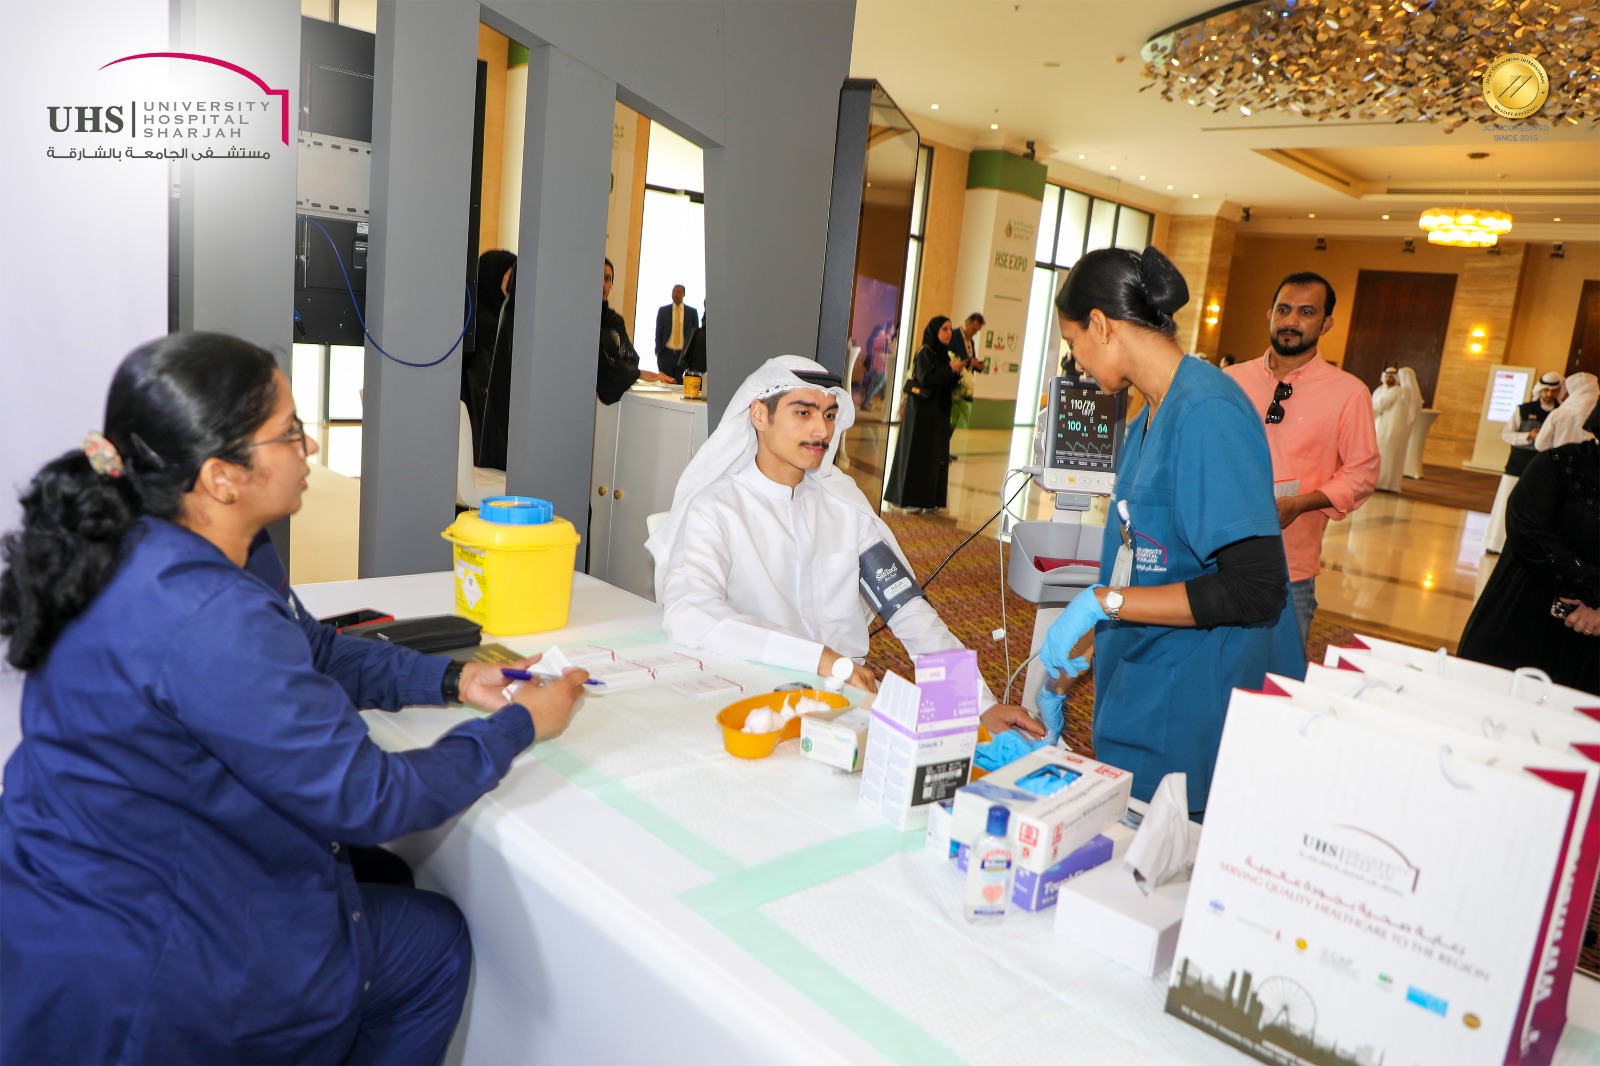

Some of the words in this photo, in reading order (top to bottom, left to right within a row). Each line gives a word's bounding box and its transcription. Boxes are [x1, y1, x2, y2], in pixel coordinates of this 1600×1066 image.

[994, 251, 1009, 268] HSE
[1009, 254, 1028, 272] EXPO
[1070, 398, 1096, 411] 110/76
[1067, 420, 1081, 431] 100
[1097, 422, 1108, 434] 64
[1303, 834, 1337, 857] UHS
[1220, 861, 1262, 888] SERVING
[1264, 880, 1313, 907] QUALITY
[1314, 901, 1388, 939] HEALTHCARE
[1391, 933, 1409, 949] TO
[1411, 940, 1434, 959] THE
[1438, 953, 1491, 983] REGION
